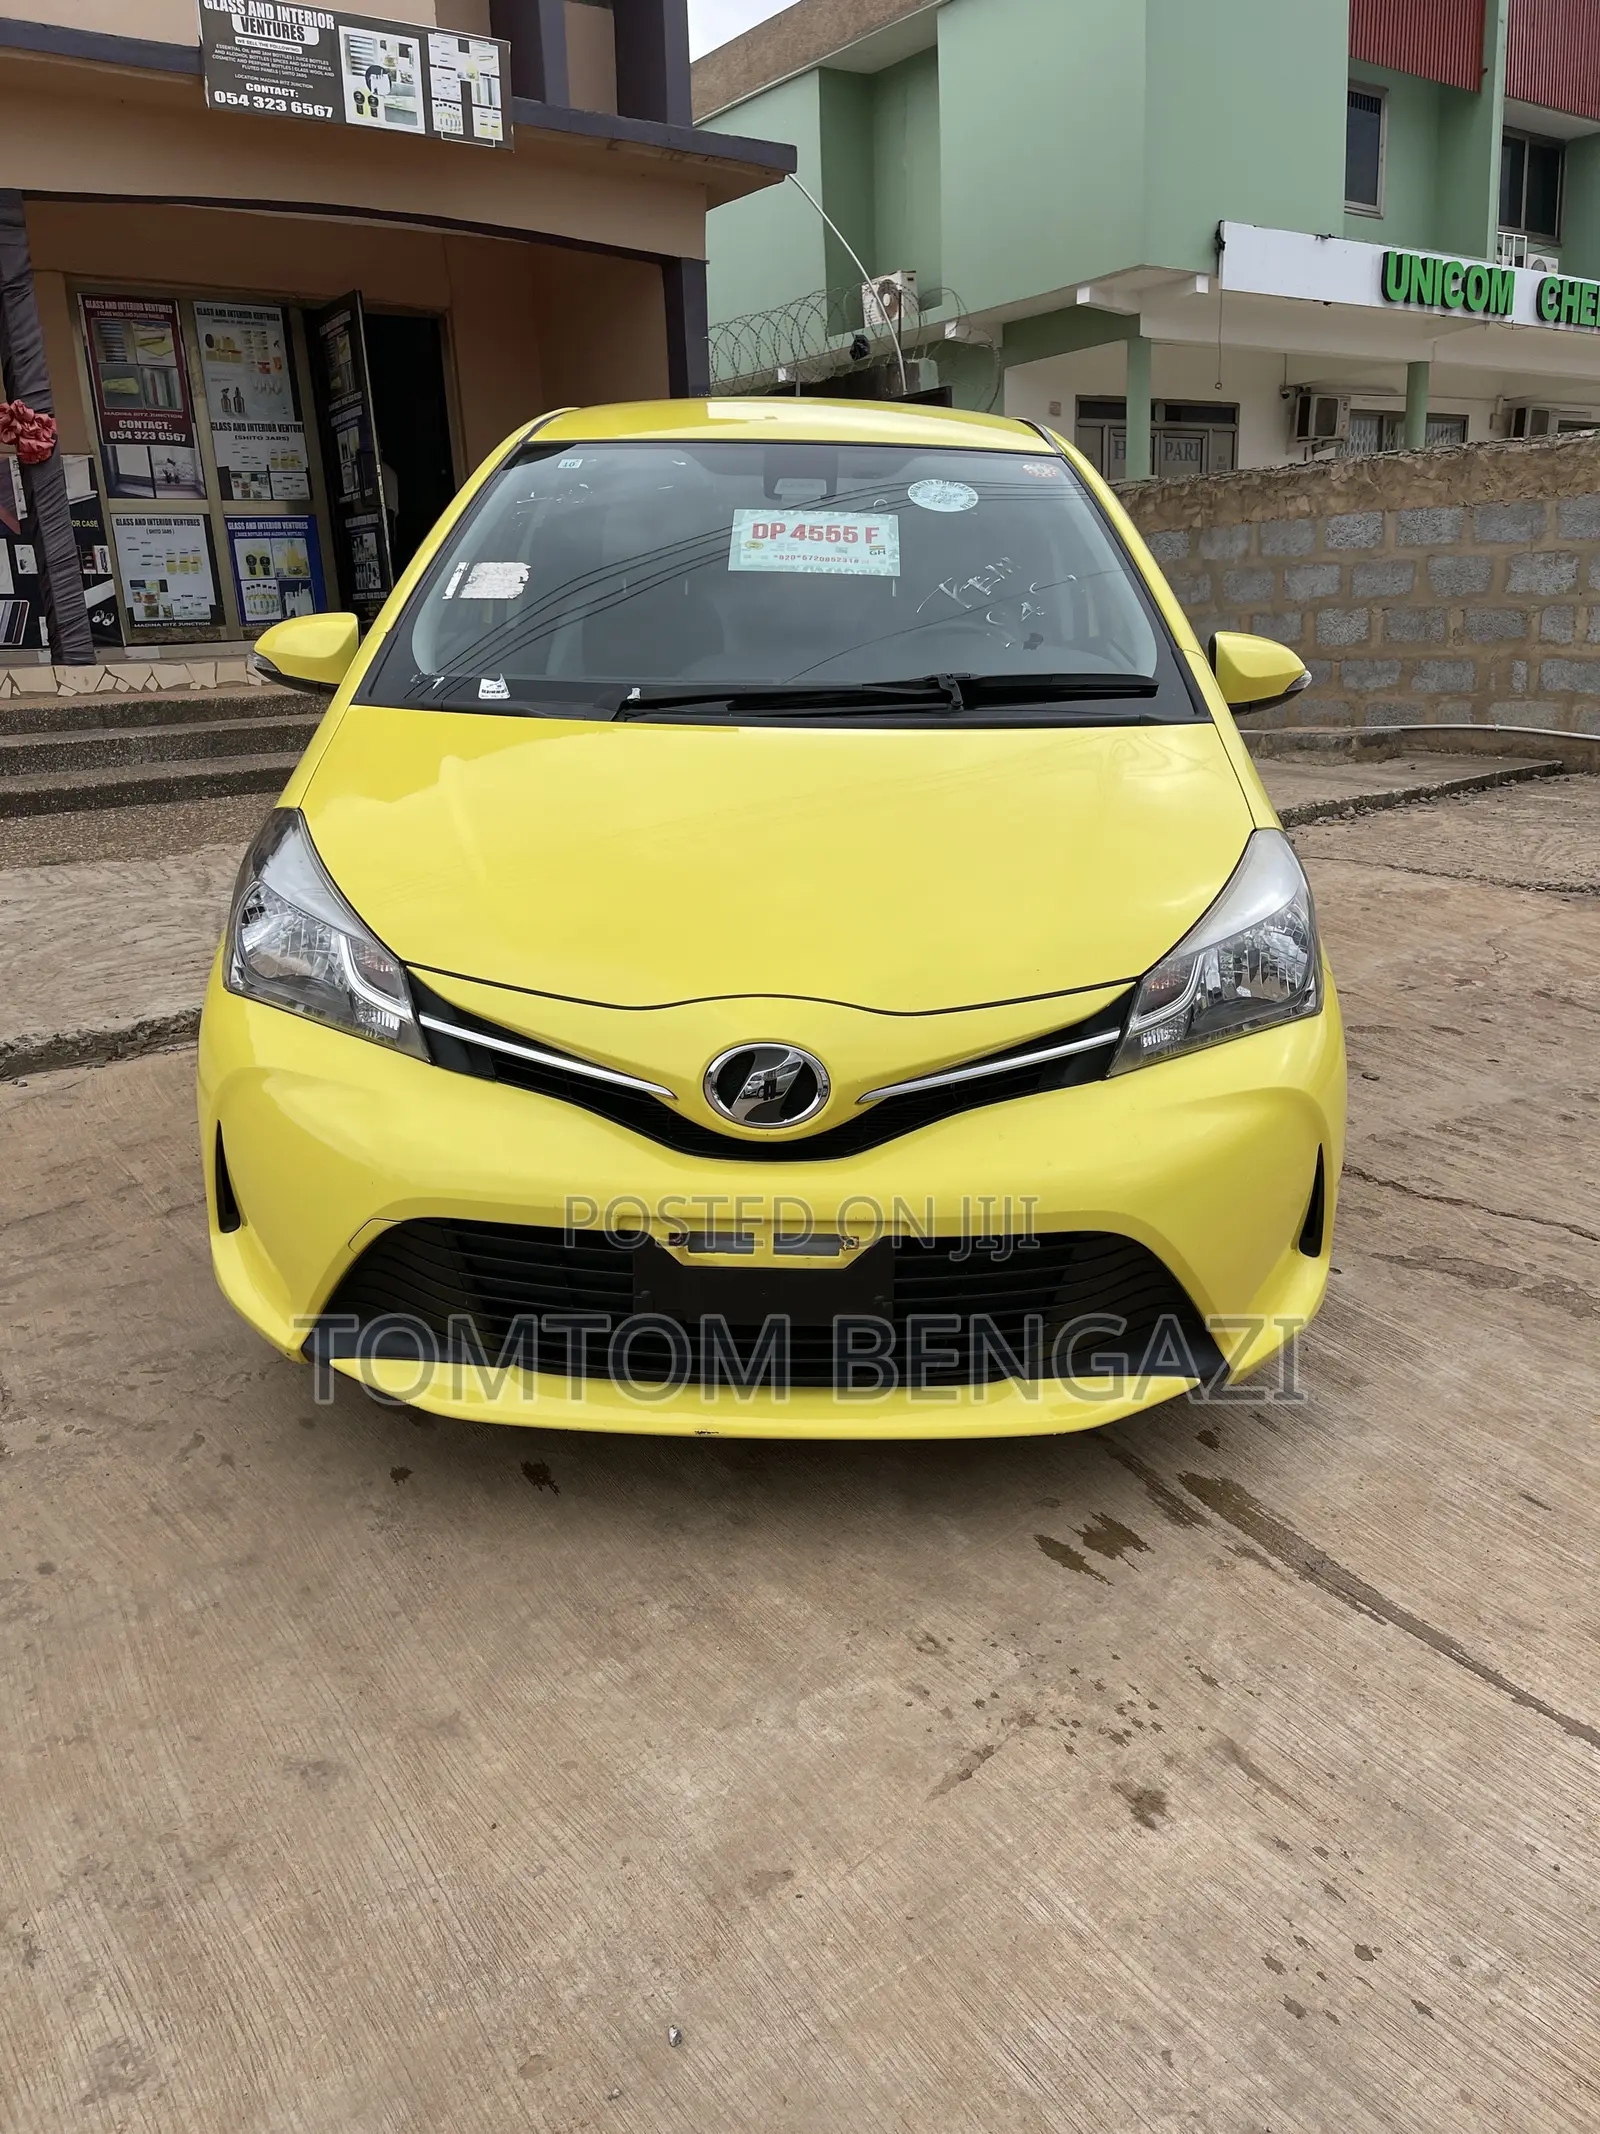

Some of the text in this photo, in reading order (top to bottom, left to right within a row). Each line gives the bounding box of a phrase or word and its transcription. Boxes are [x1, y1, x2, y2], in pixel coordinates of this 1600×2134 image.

[203, 0, 335, 30] GLASS AND INTERIOR
[240, 16, 305, 42] VENTURES
[212, 54, 236, 62] COSMETIC
[226, 50, 248, 59] ALCOHOL
[249, 54, 270, 62] BOTTLES
[272, 52, 292, 60] BOTTLES
[309, 58, 329, 66] BOTTLES
[245, 82, 299, 98] CONTACT:
[214, 90, 334, 118] 054 323 6567
[1382, 251, 1600, 327] UNICOM CHE
[118, 419, 173, 430] CONTACT:
[210, 421, 304, 434] GLASS AND INTERIOR VENTUR
[109, 430, 186, 442] 054 323 6567
[81, 519, 99, 528] CASE
[115, 518, 201, 527] GLASS AND INTERIOR VENTURES
[227, 521, 245, 530] GLASS
[245, 521, 257, 530] AND
[752, 522, 880, 544] DP 4555 F
